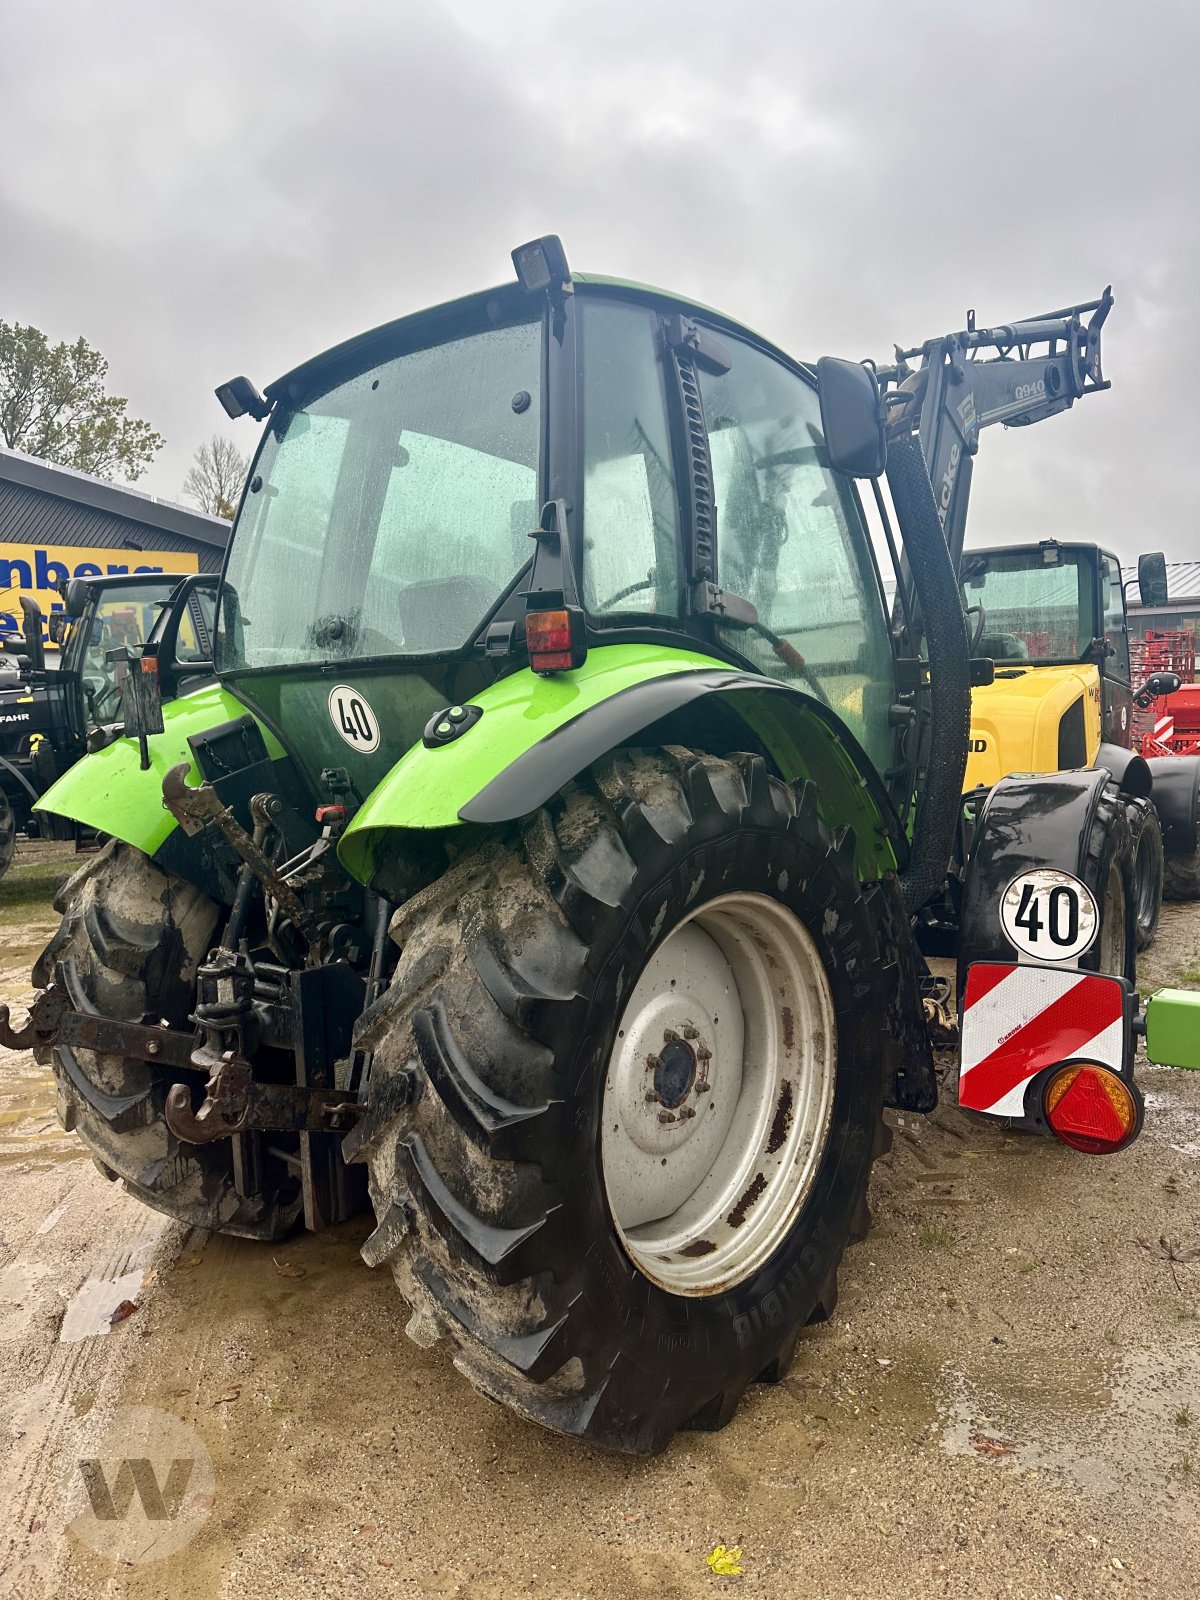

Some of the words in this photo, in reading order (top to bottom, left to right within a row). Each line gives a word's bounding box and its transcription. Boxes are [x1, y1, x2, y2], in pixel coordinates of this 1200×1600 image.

[1015, 380, 1046, 400] Q940
[939, 444, 960, 528] icke
[0, 550, 163, 591] nbe
[0, 713, 30, 723] FAHR
[338, 698, 373, 741] 40
[1014, 883, 1079, 947] 40
[1004, 1023, 1022, 1040] KRONE
